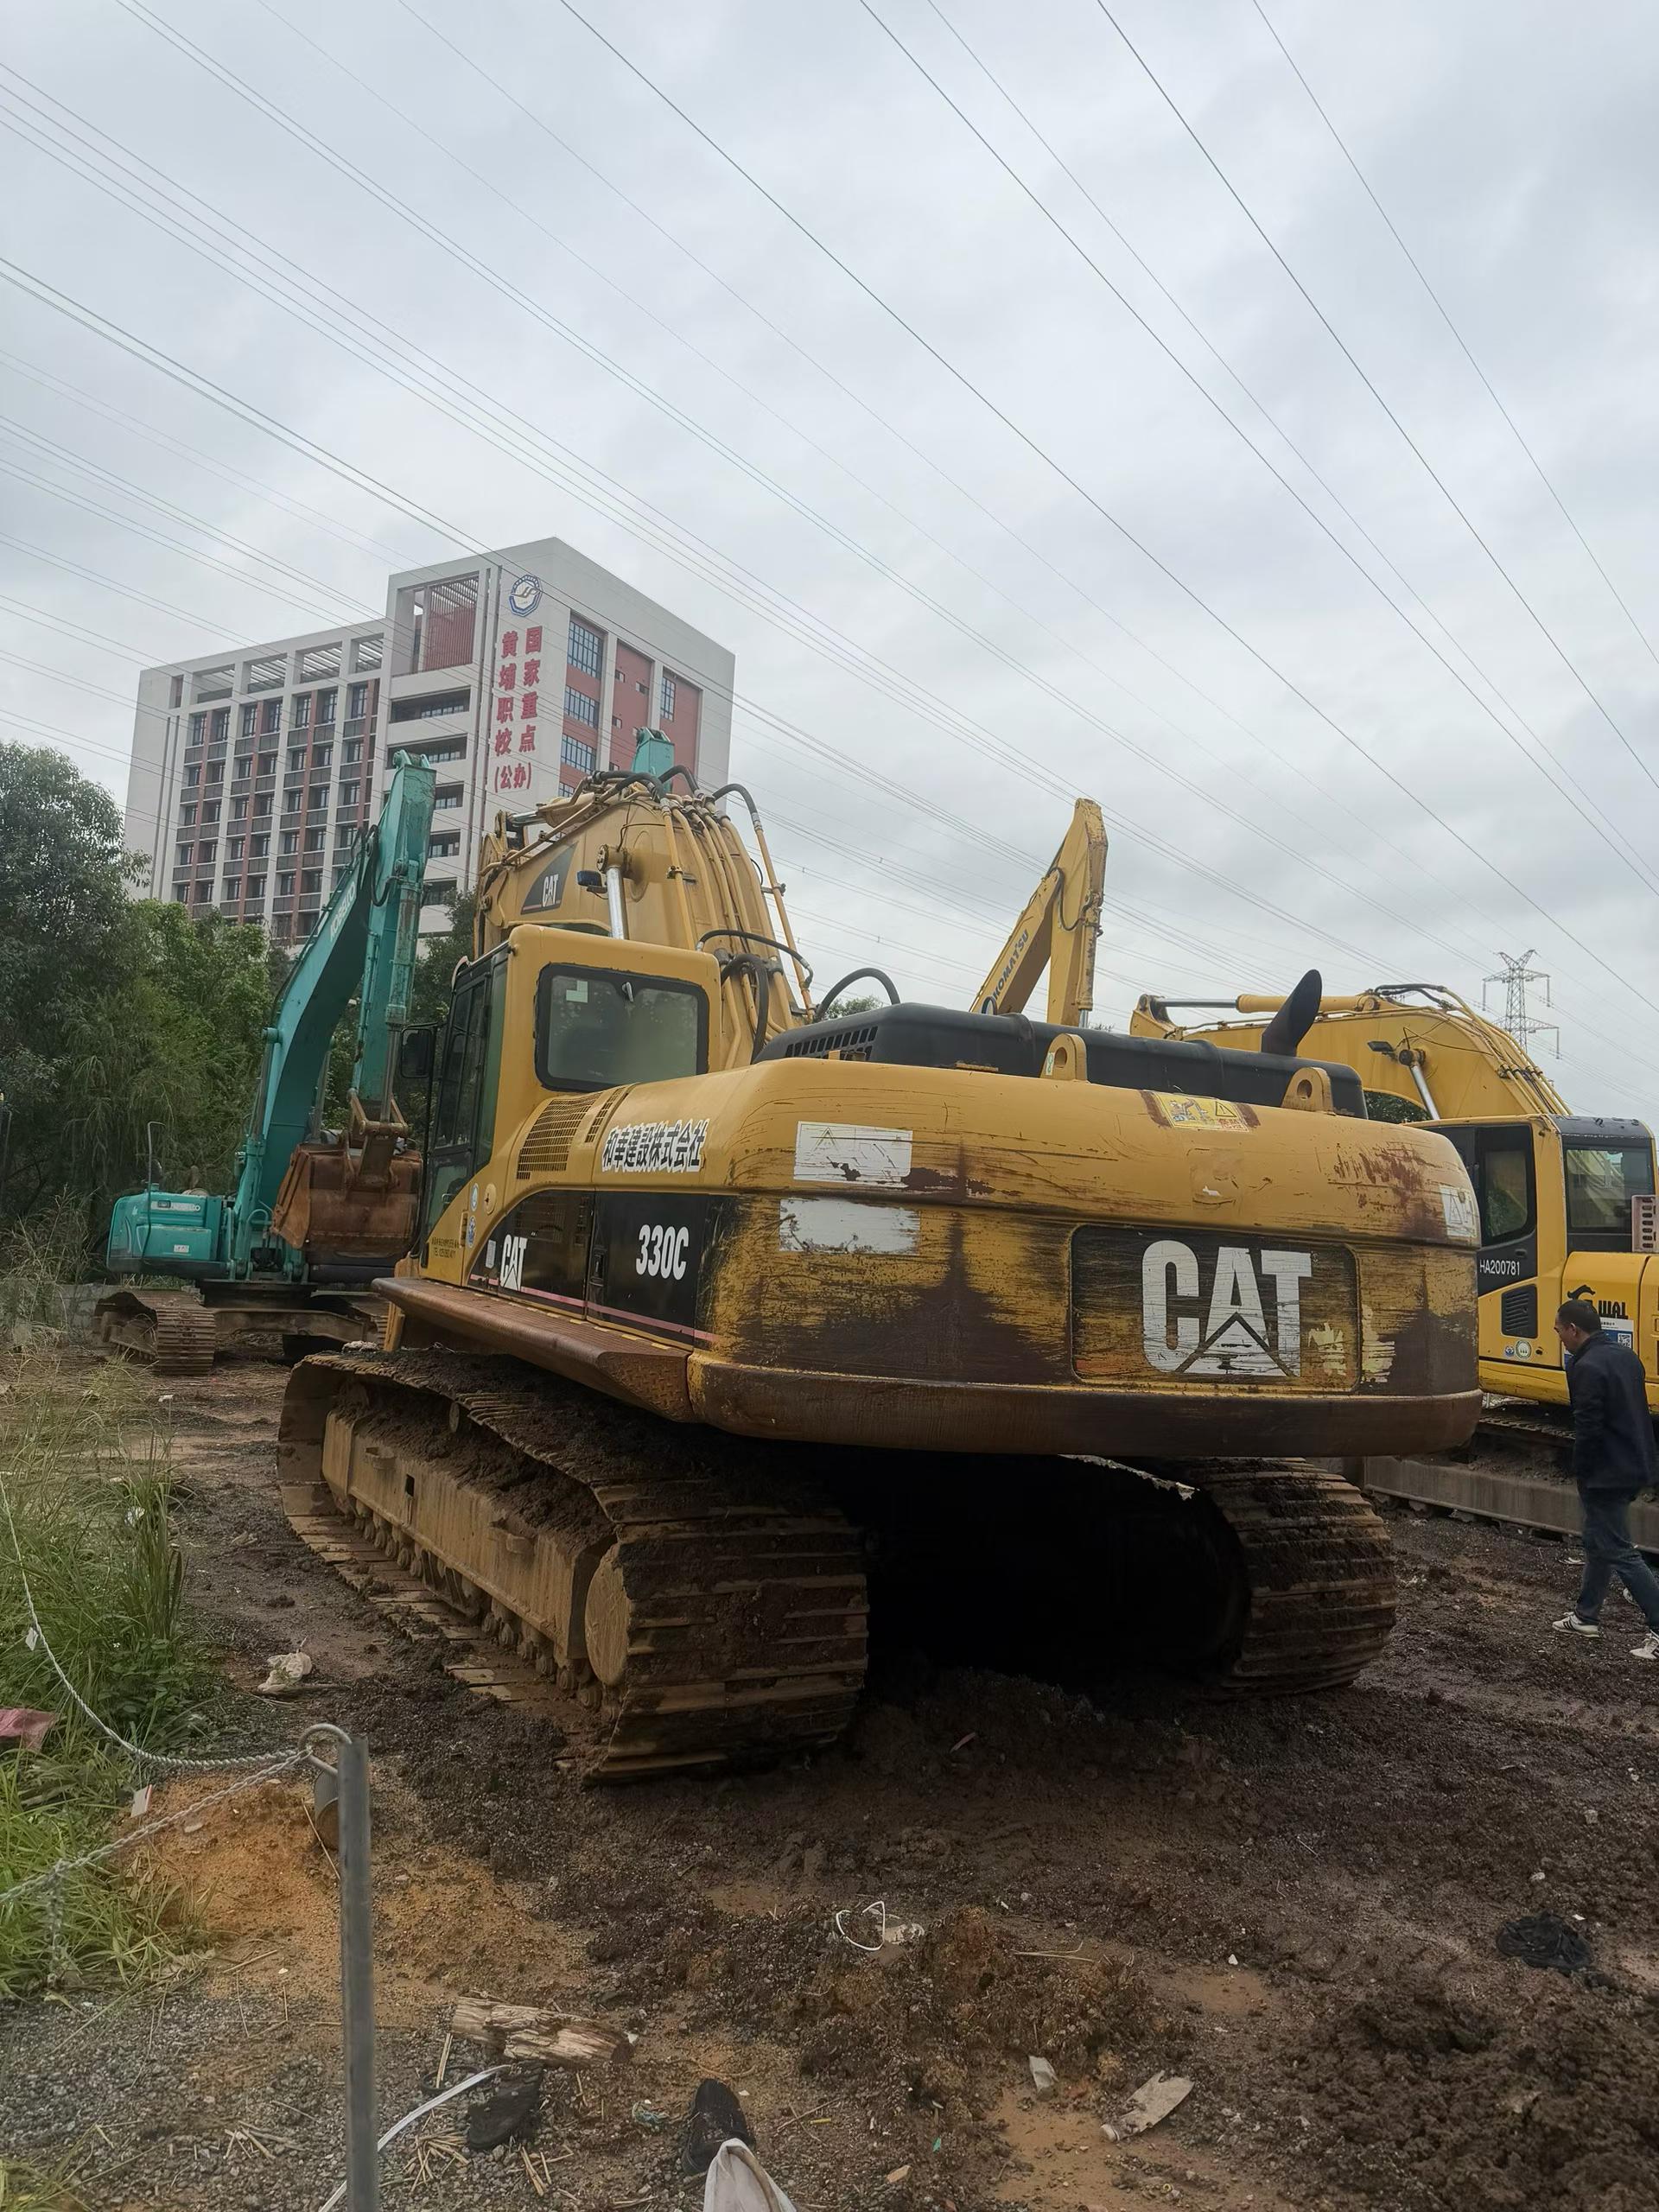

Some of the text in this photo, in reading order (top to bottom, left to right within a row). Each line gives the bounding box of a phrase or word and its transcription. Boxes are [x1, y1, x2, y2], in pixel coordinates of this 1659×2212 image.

[494, 631, 518, 757] 黄埔职校
[518, 626, 543, 753] 国家重点
[543, 874, 559, 907] CAT
[993, 929, 1028, 1000] KOMATSU
[499, 1234, 528, 1291] CAT
[635, 1224, 690, 1281] 330C
[1479, 1259, 1520, 1276] HA200781
[1141, 1239, 1312, 1376] CAT
